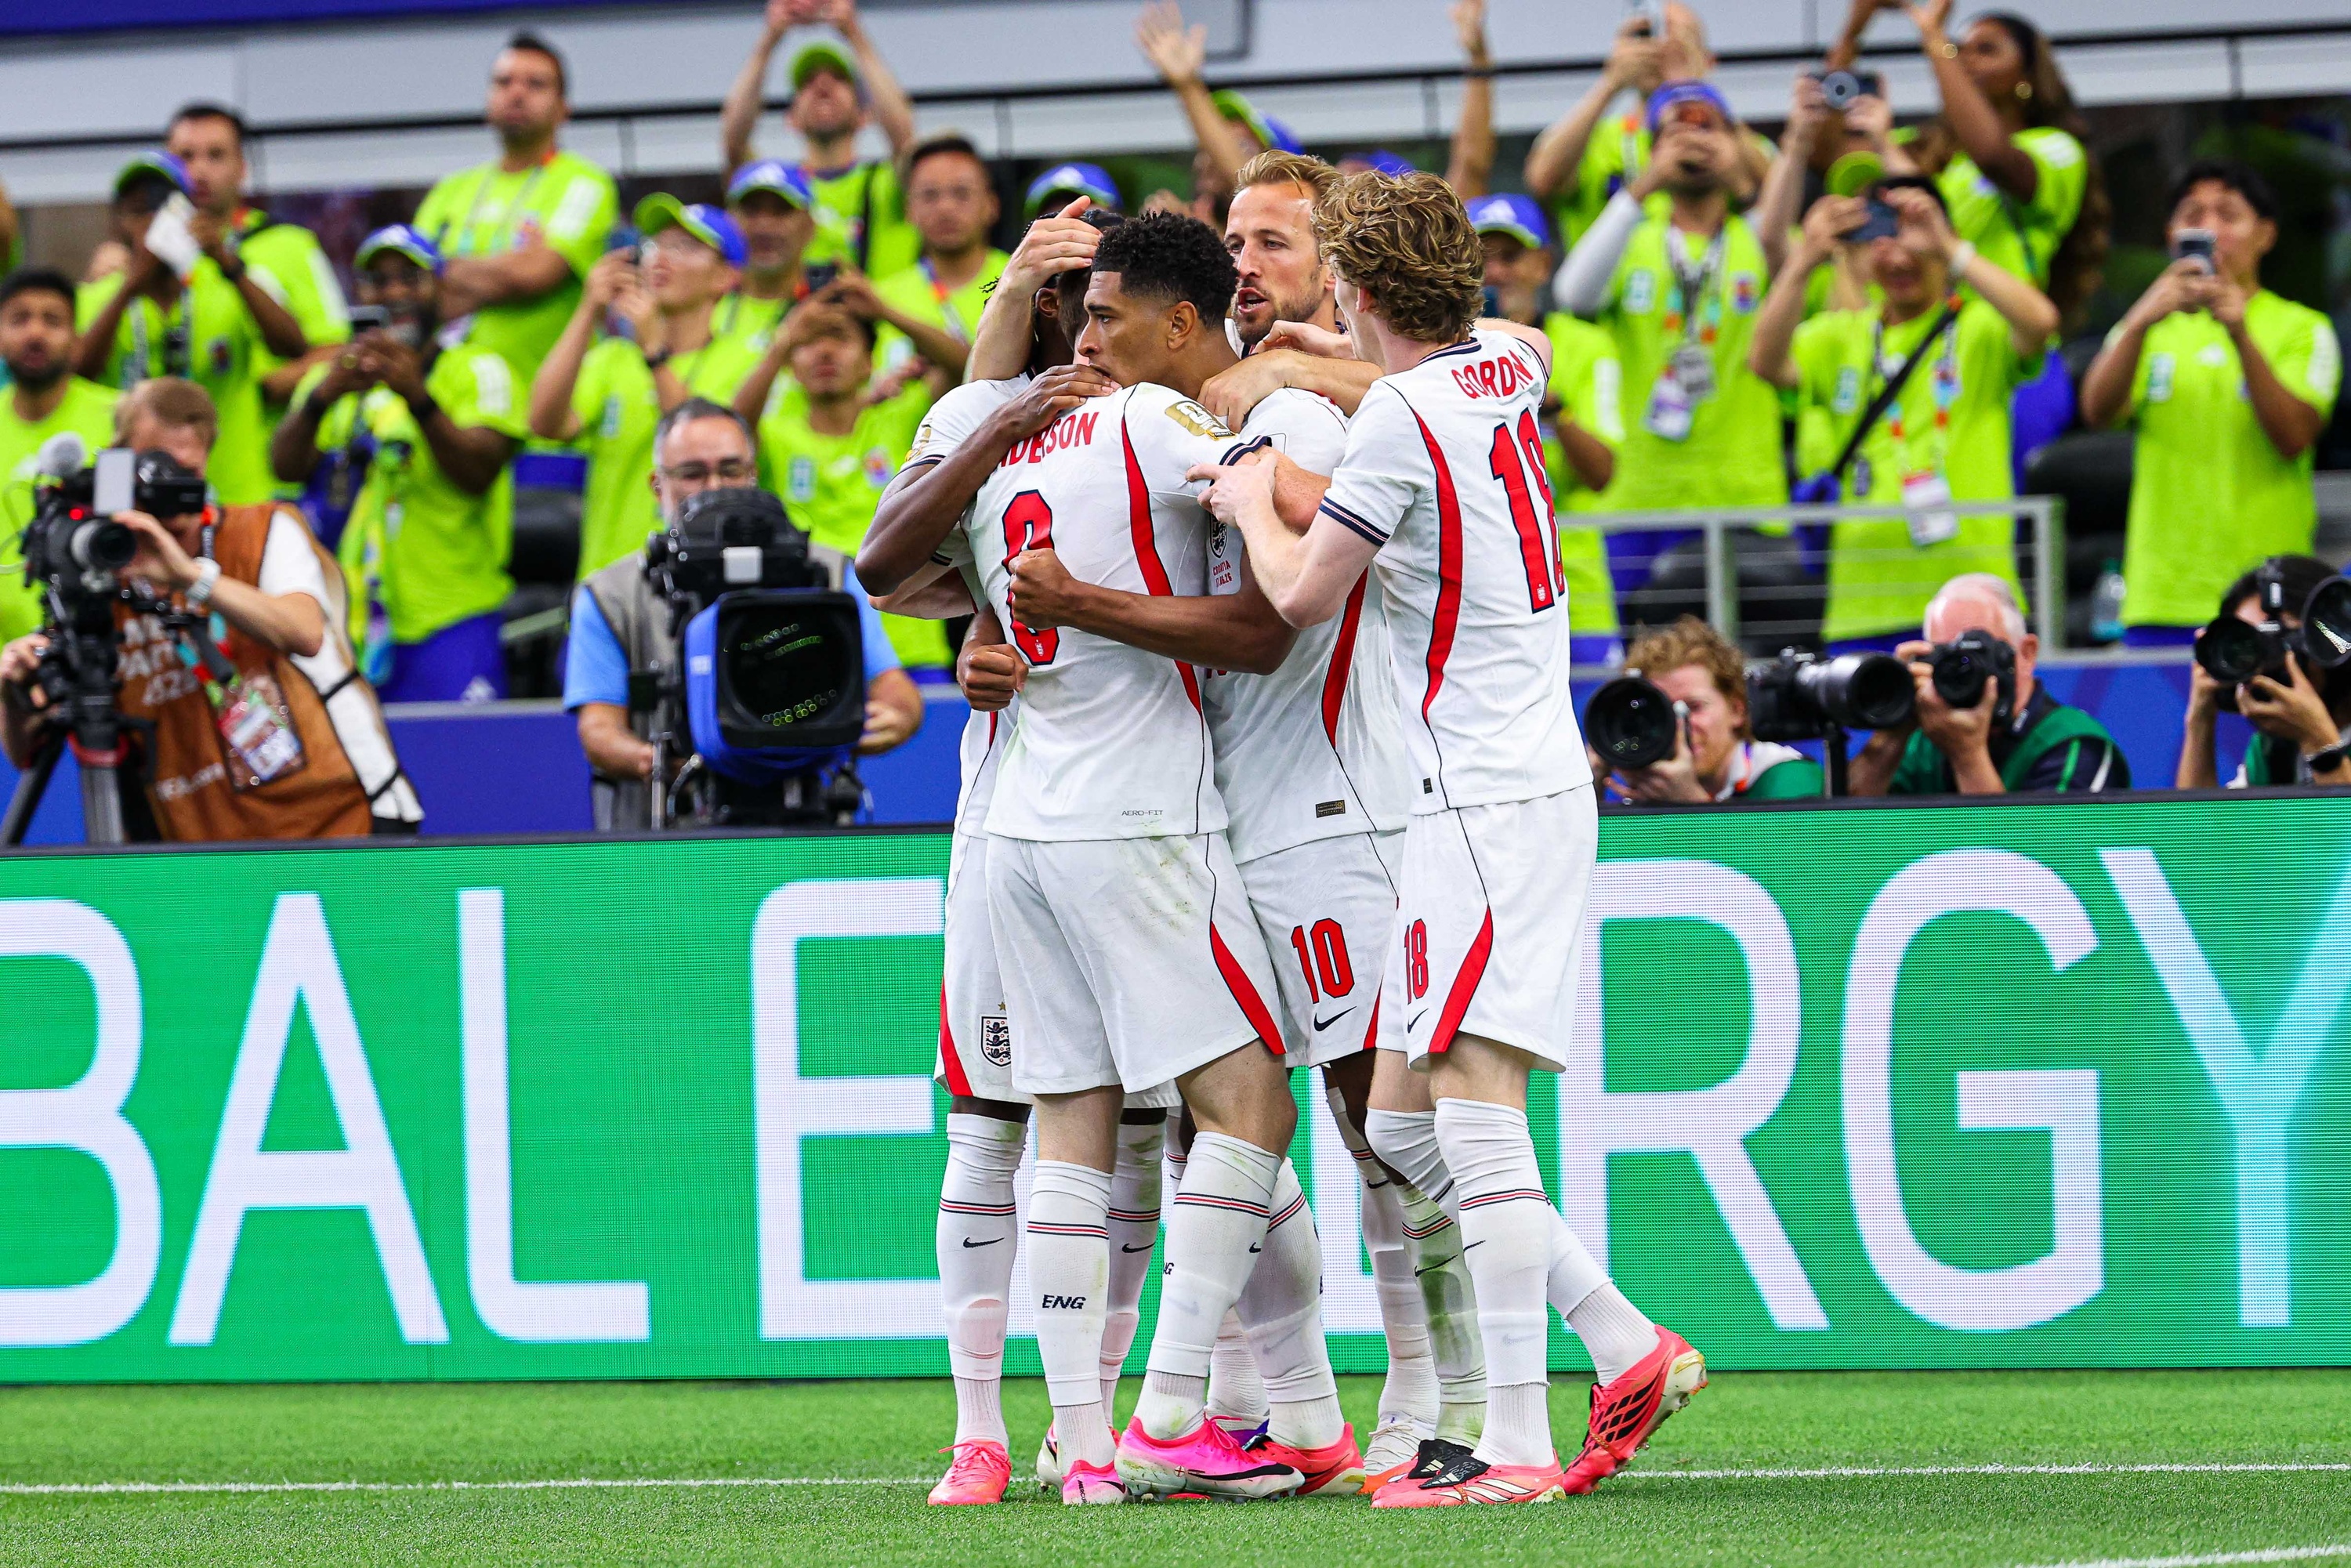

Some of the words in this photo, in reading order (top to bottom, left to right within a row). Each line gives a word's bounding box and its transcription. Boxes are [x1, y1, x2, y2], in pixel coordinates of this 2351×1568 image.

[1488, 407, 1565, 614] 18
[1290, 918, 1355, 1005] 10
[1404, 918, 1429, 1005] 18
[750, 846, 2351, 1342] ERGY
[1041, 1294, 1087, 1309] ENG
